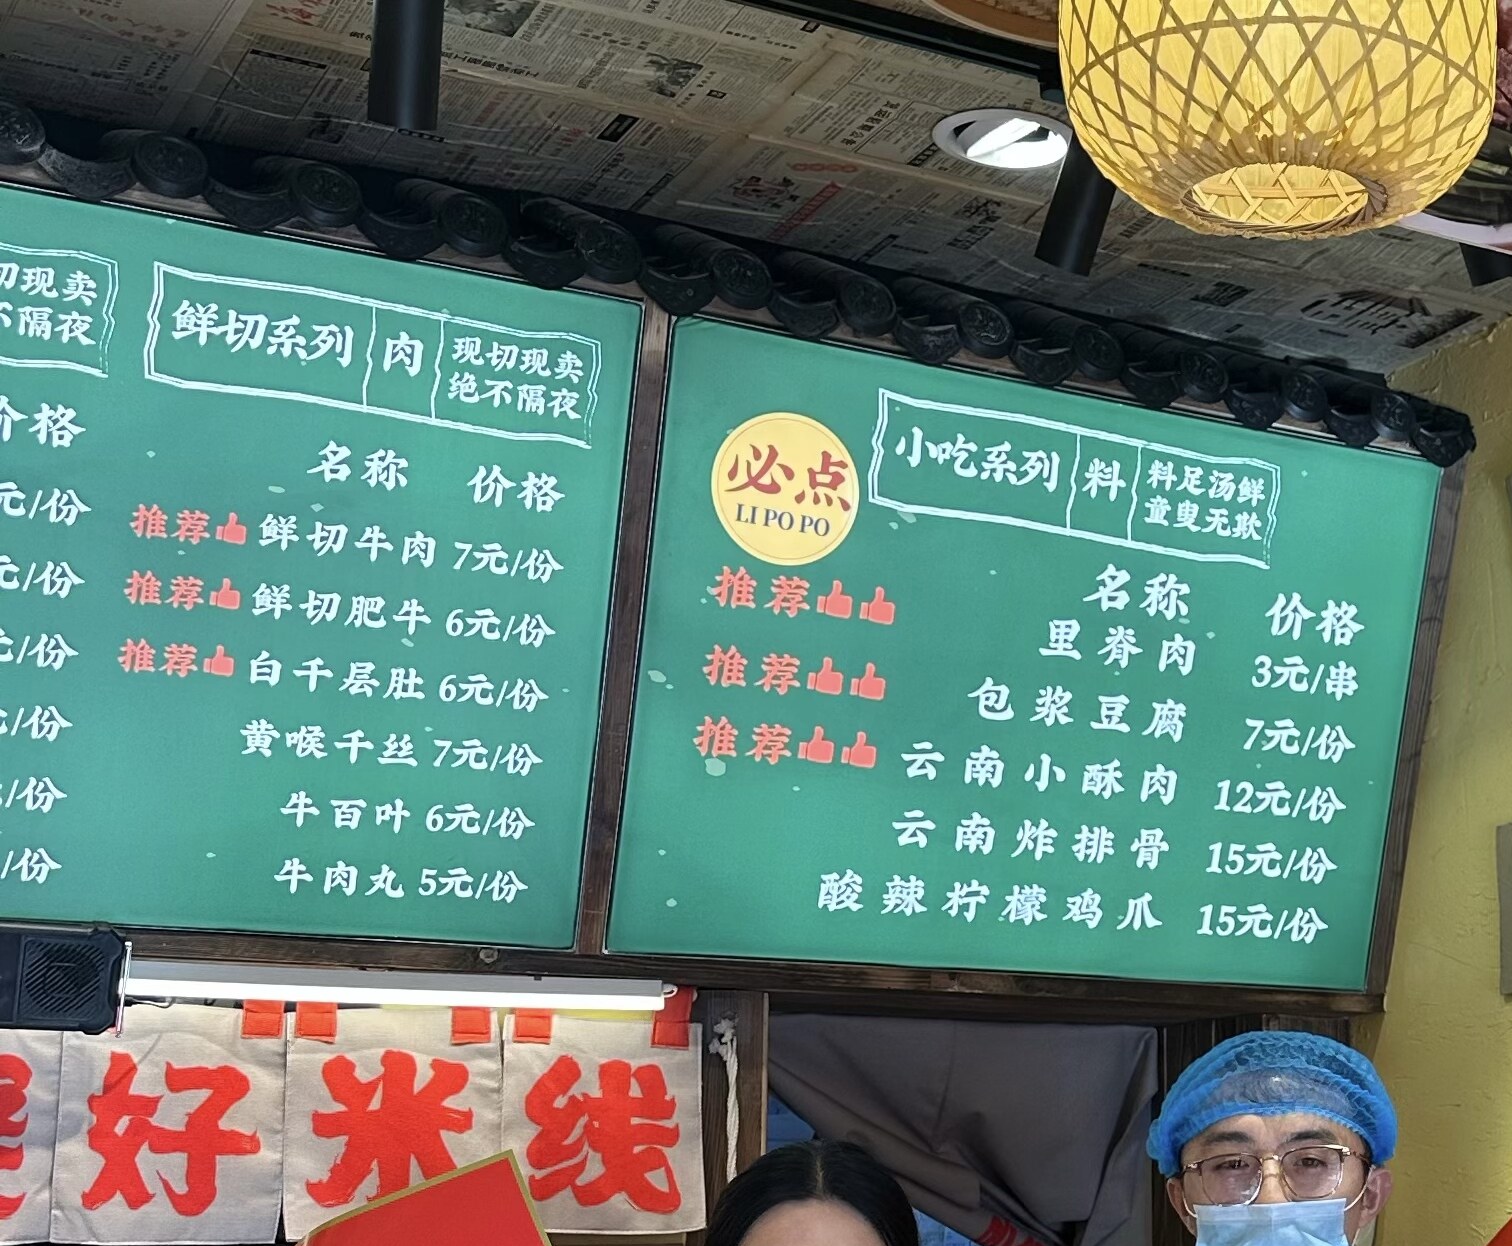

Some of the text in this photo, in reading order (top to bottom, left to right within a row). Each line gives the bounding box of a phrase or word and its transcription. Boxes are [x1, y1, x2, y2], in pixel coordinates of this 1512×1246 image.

[172, 299, 584, 381] 鲜切系列 肉 现切现卖
[448, 376, 582, 420] 绝不隔夜
[307, 441, 565, 512] 名称 价格
[724, 443, 852, 513] 必点
[896, 424, 1268, 506] 小吃系列 料 料足汤鲜
[129, 503, 564, 583] 推荐 鲜切牛肉 7元/份
[735, 503, 831, 537] LI PO PO
[1144, 494, 1264, 542] 童叟无欺
[124, 569, 555, 647] 推荐 鲜切肥牛 6元/份
[712, 564, 1364, 646] 推荐 名称 价格
[117, 638, 548, 712] 推荐 白千层肚 6元/份
[1039, 620, 1358, 700] 里脊肉 3元/串
[700, 644, 1355, 763] 推荐 包浆豆腐 7元/份
[240, 719, 542, 776] 黄喉千丝 7元/份
[692, 714, 1346, 823] 推荐 云南小酥肉 12元/份
[280, 791, 535, 839] 牛百叶 6元/份
[892, 810, 1337, 884] 云南炸排骨 15元/份
[274, 858, 528, 903] 牛肉丸 5元/份
[818, 869, 1328, 943] 酸辣柠檬鸡爪 15元/份
[0, 1048, 682, 1217] 好米线
